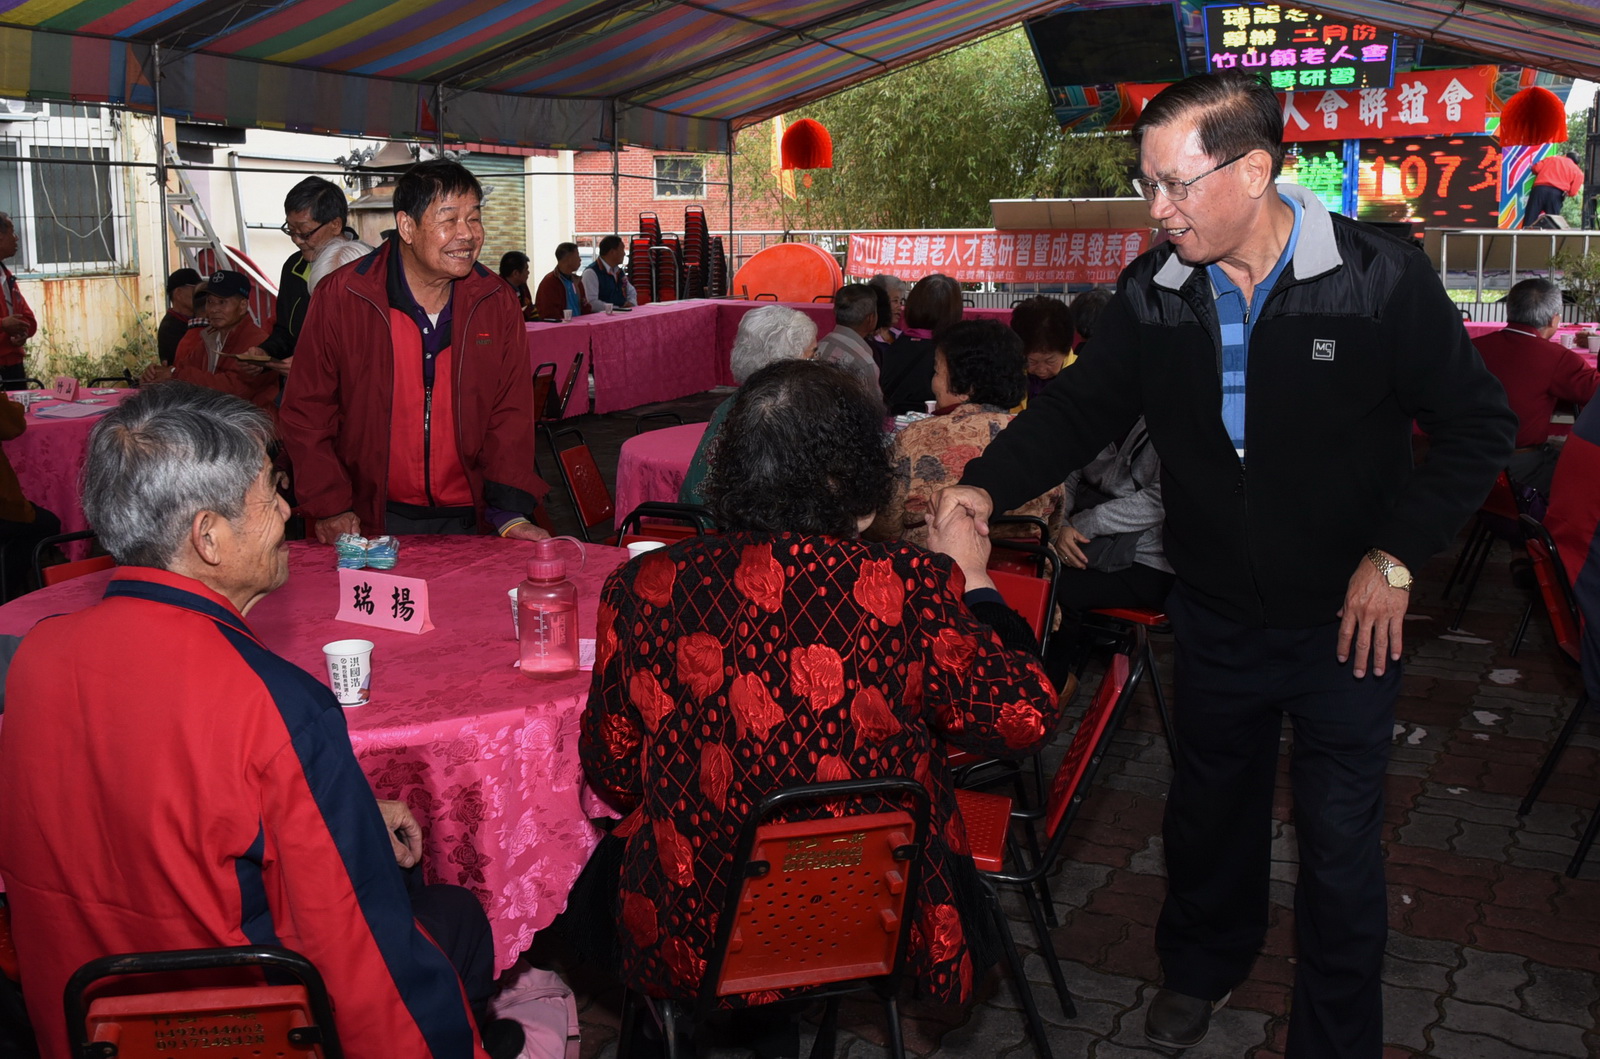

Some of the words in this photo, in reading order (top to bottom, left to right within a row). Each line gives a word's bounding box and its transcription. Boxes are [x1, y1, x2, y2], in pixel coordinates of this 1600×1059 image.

[1211, 44, 1389, 68] 竹山鎮老人會
[1256, 67, 1356, 87] 藝研習
[851, 232, 1142, 267] 竹山鎮全鎮老人才藝研習暨成果發表會
